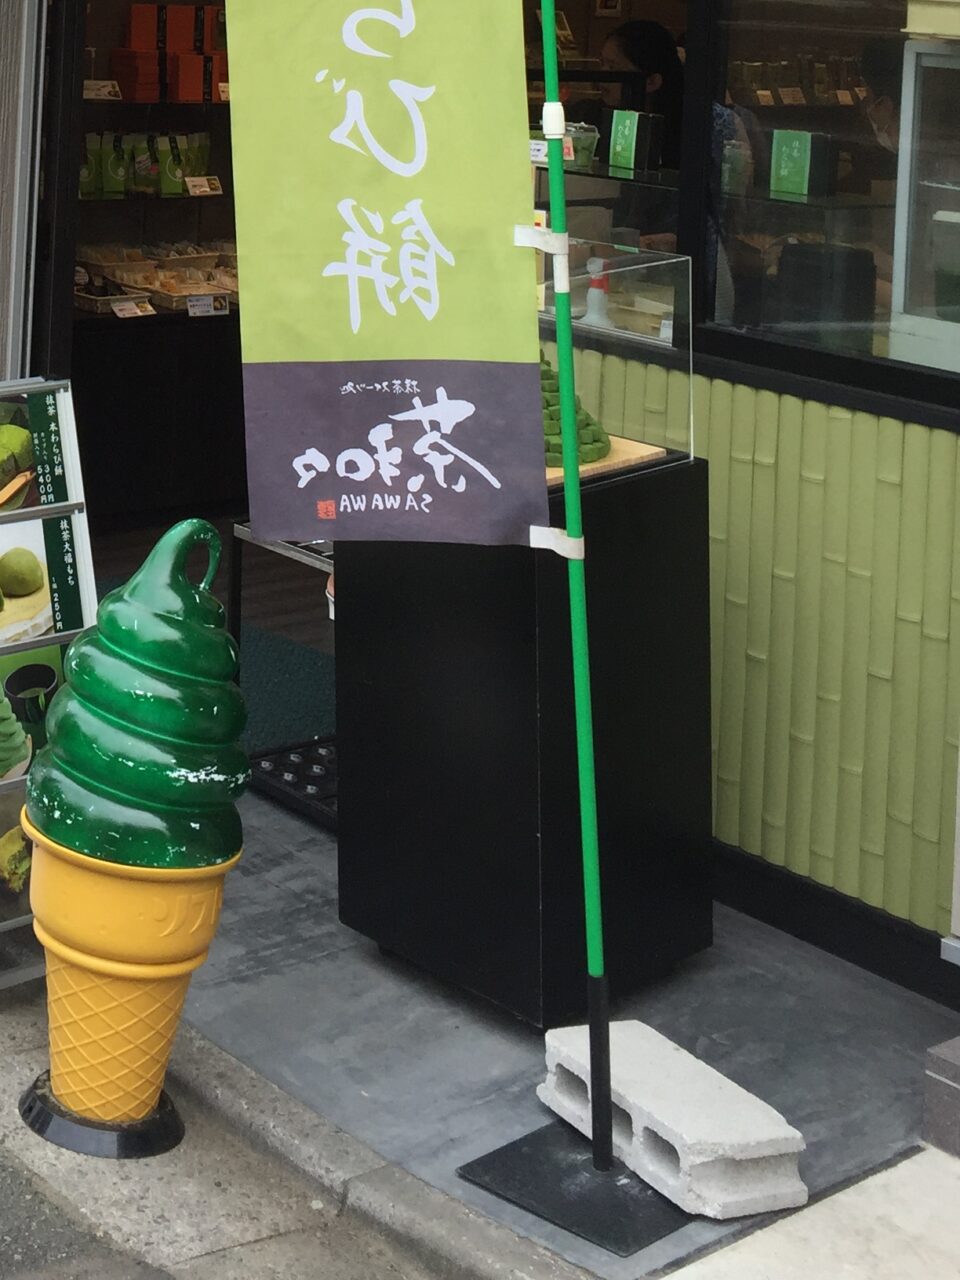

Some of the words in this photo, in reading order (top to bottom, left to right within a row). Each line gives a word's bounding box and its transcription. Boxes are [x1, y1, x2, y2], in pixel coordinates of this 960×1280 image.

[46, 394, 56, 416] 抹茶
[37, 465, 48, 504] 540円
[44, 464, 54, 502] 300円
[60, 519, 74, 586] 抹茶大福もち
[53, 593, 63, 630] 250円
